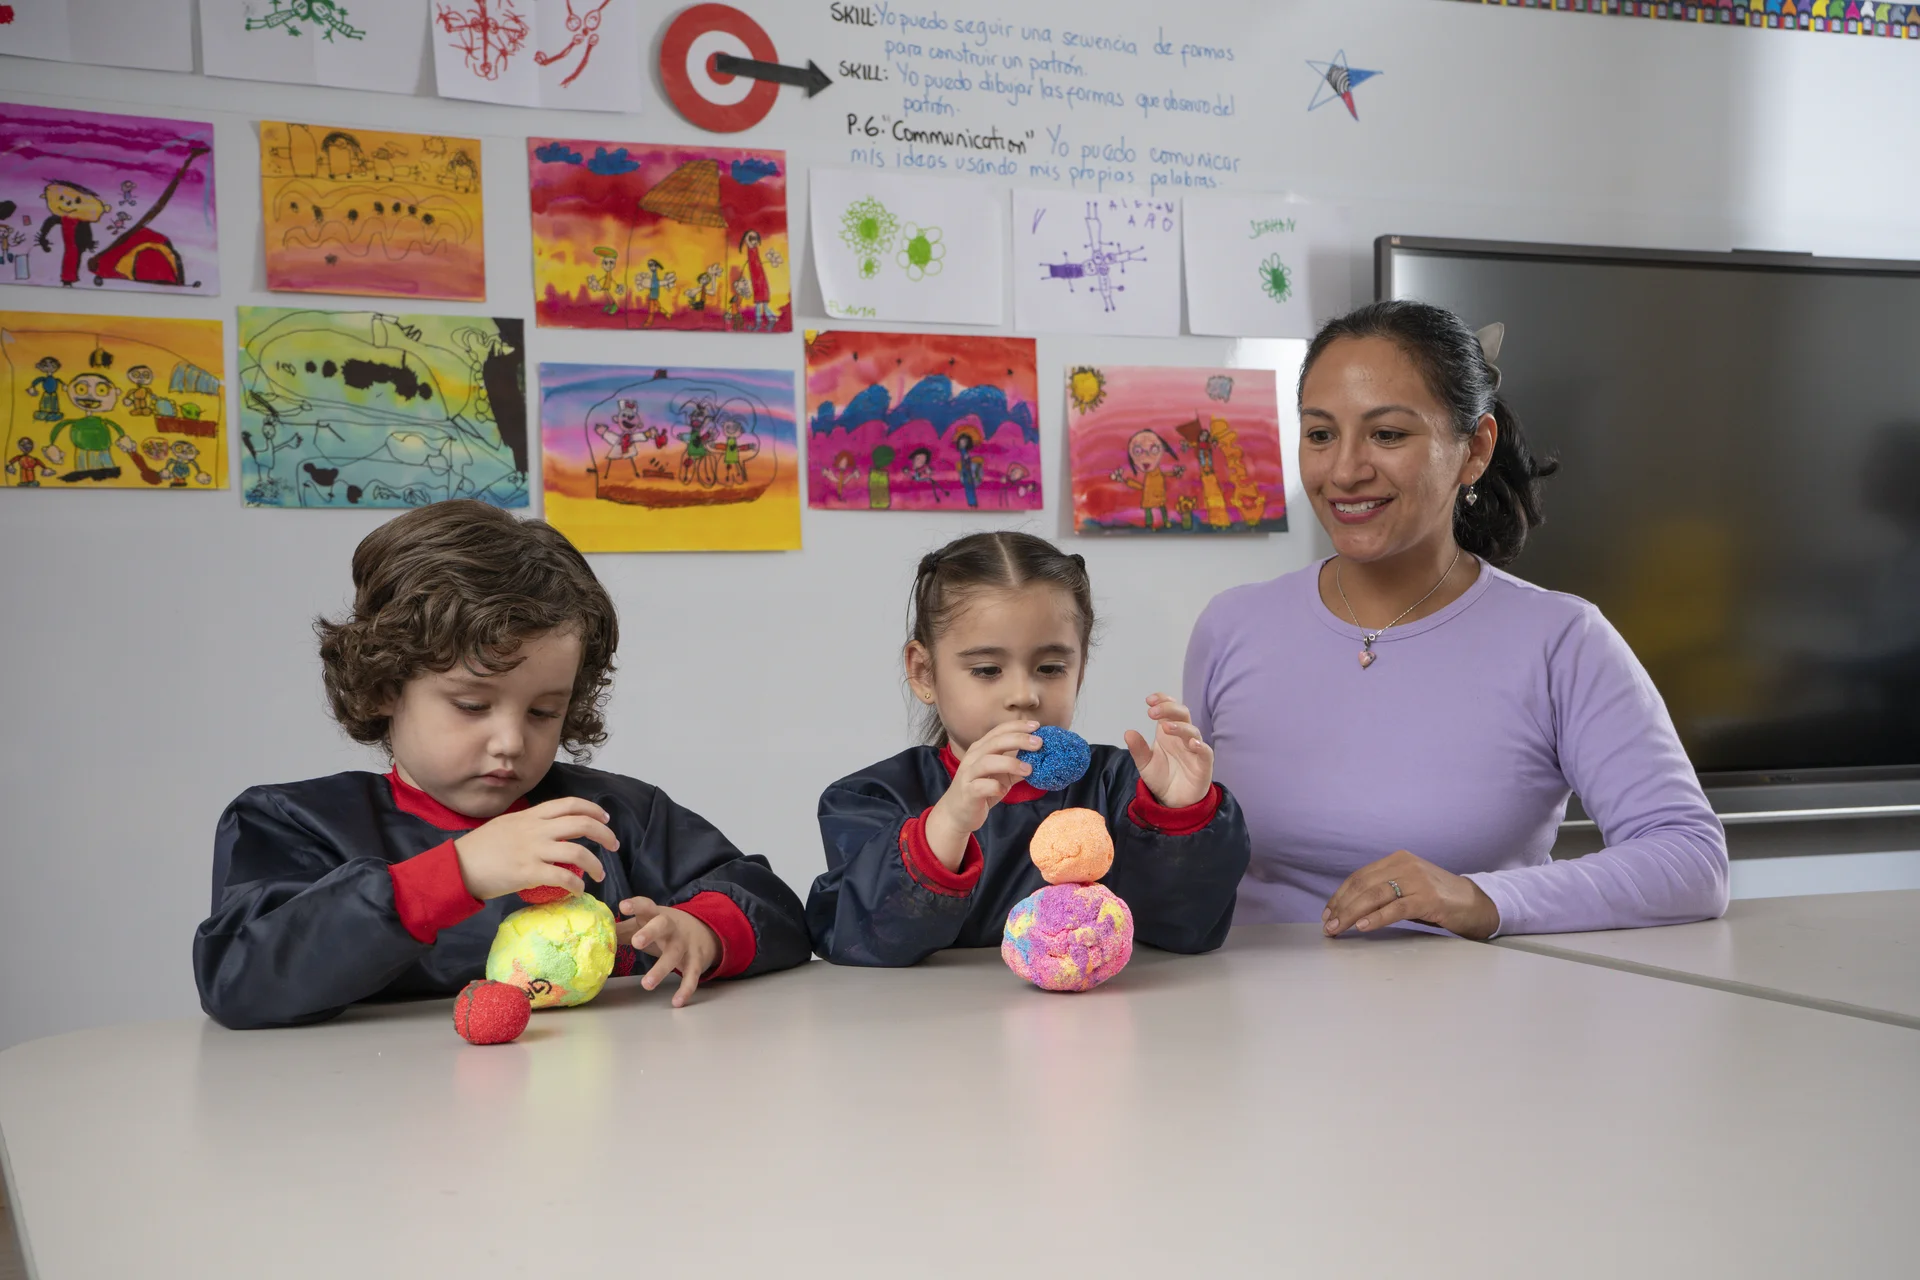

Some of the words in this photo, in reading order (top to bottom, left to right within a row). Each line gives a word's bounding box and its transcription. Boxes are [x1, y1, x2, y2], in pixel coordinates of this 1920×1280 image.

[885, 40, 921, 60] para
[929, 42, 998, 66] construir
[1003, 55, 1023, 69] un
[1029, 50, 1088, 80] patrón.
[900, 11, 948, 35] puedo
[954, 18, 1013, 47] seguir
[1021, 26, 1052, 43] una
[1154, 26, 1174, 55] de
[1180, 44, 1234, 68] formas
[839, 60, 888, 81] SKILL:
[897, 62, 919, 86] Yo
[924, 70, 972, 97] puedo
[979, 69, 1033, 106] dibujar
[1040, 78, 1064, 100] las
[1066, 87, 1124, 110] formas
[1136, 93, 1160, 119] que
[1163, 90, 1211, 114] observo
[1212, 94, 1234, 117] del
[851, 142, 885, 168] mis
[896, 143, 947, 169] ideas
[956, 155, 1018, 176] usando
[1030, 160, 1060, 181] mis
[1069, 166, 1135, 193] propias
[1046, 124, 1069, 155] Yo
[1081, 136, 1136, 170] puedo
[1149, 147, 1241, 173] comunicar
